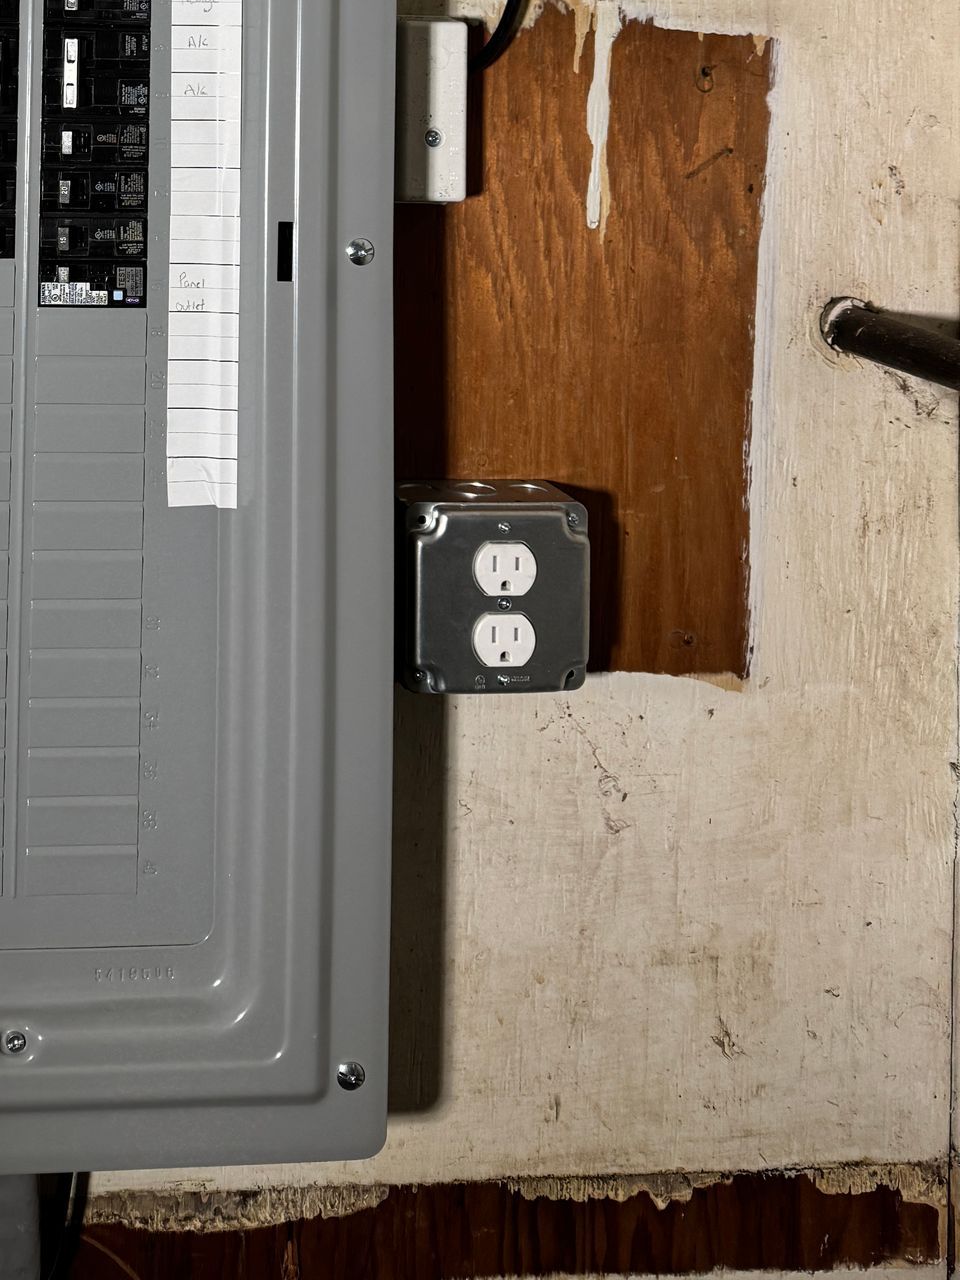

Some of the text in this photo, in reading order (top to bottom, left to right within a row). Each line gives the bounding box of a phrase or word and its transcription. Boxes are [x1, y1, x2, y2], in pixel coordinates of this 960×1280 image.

[61, 186, 68, 195] 20
[118, 267, 126, 287] TEST
[178, 271, 206, 289] Panel
[151, 372, 166, 390] 20
